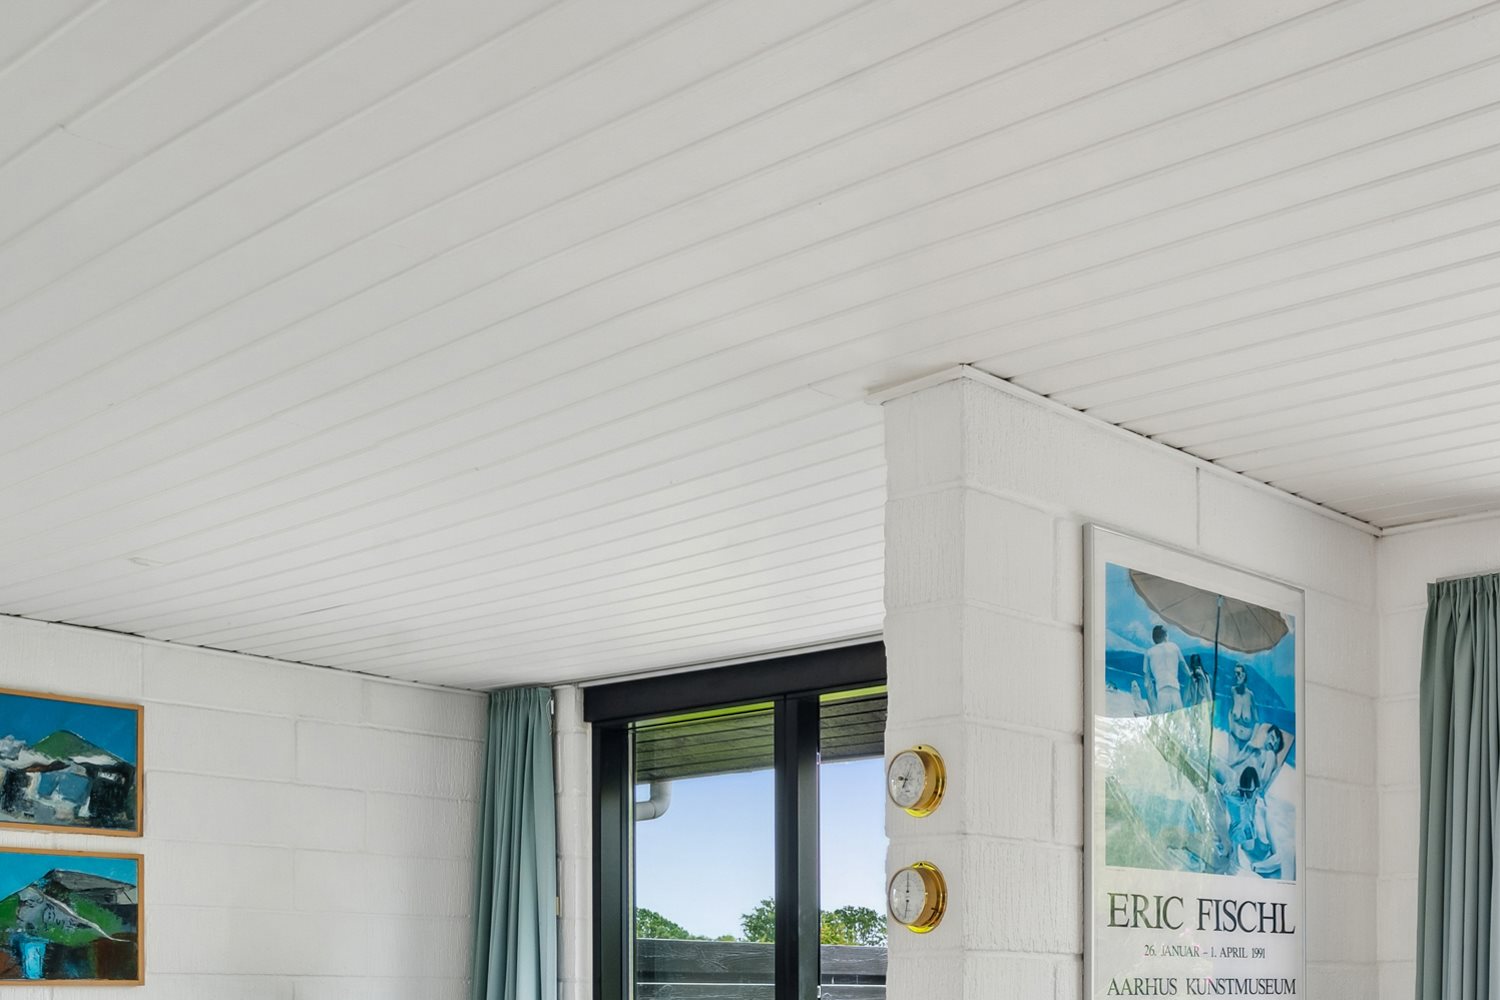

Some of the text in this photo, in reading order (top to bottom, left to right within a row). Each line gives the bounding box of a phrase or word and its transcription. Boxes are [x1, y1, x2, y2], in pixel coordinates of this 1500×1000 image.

[1106, 892, 1296, 935] ERIC FISCHL
[1144, 944, 1157, 957] 26.
[1160, 945, 1200, 958] JANUAR
[1219, 947, 1248, 959] APRIL
[1251, 947, 1266, 959] 1991
[1107, 977, 1297, 996] AARHUS KUNSTMUSEUM
